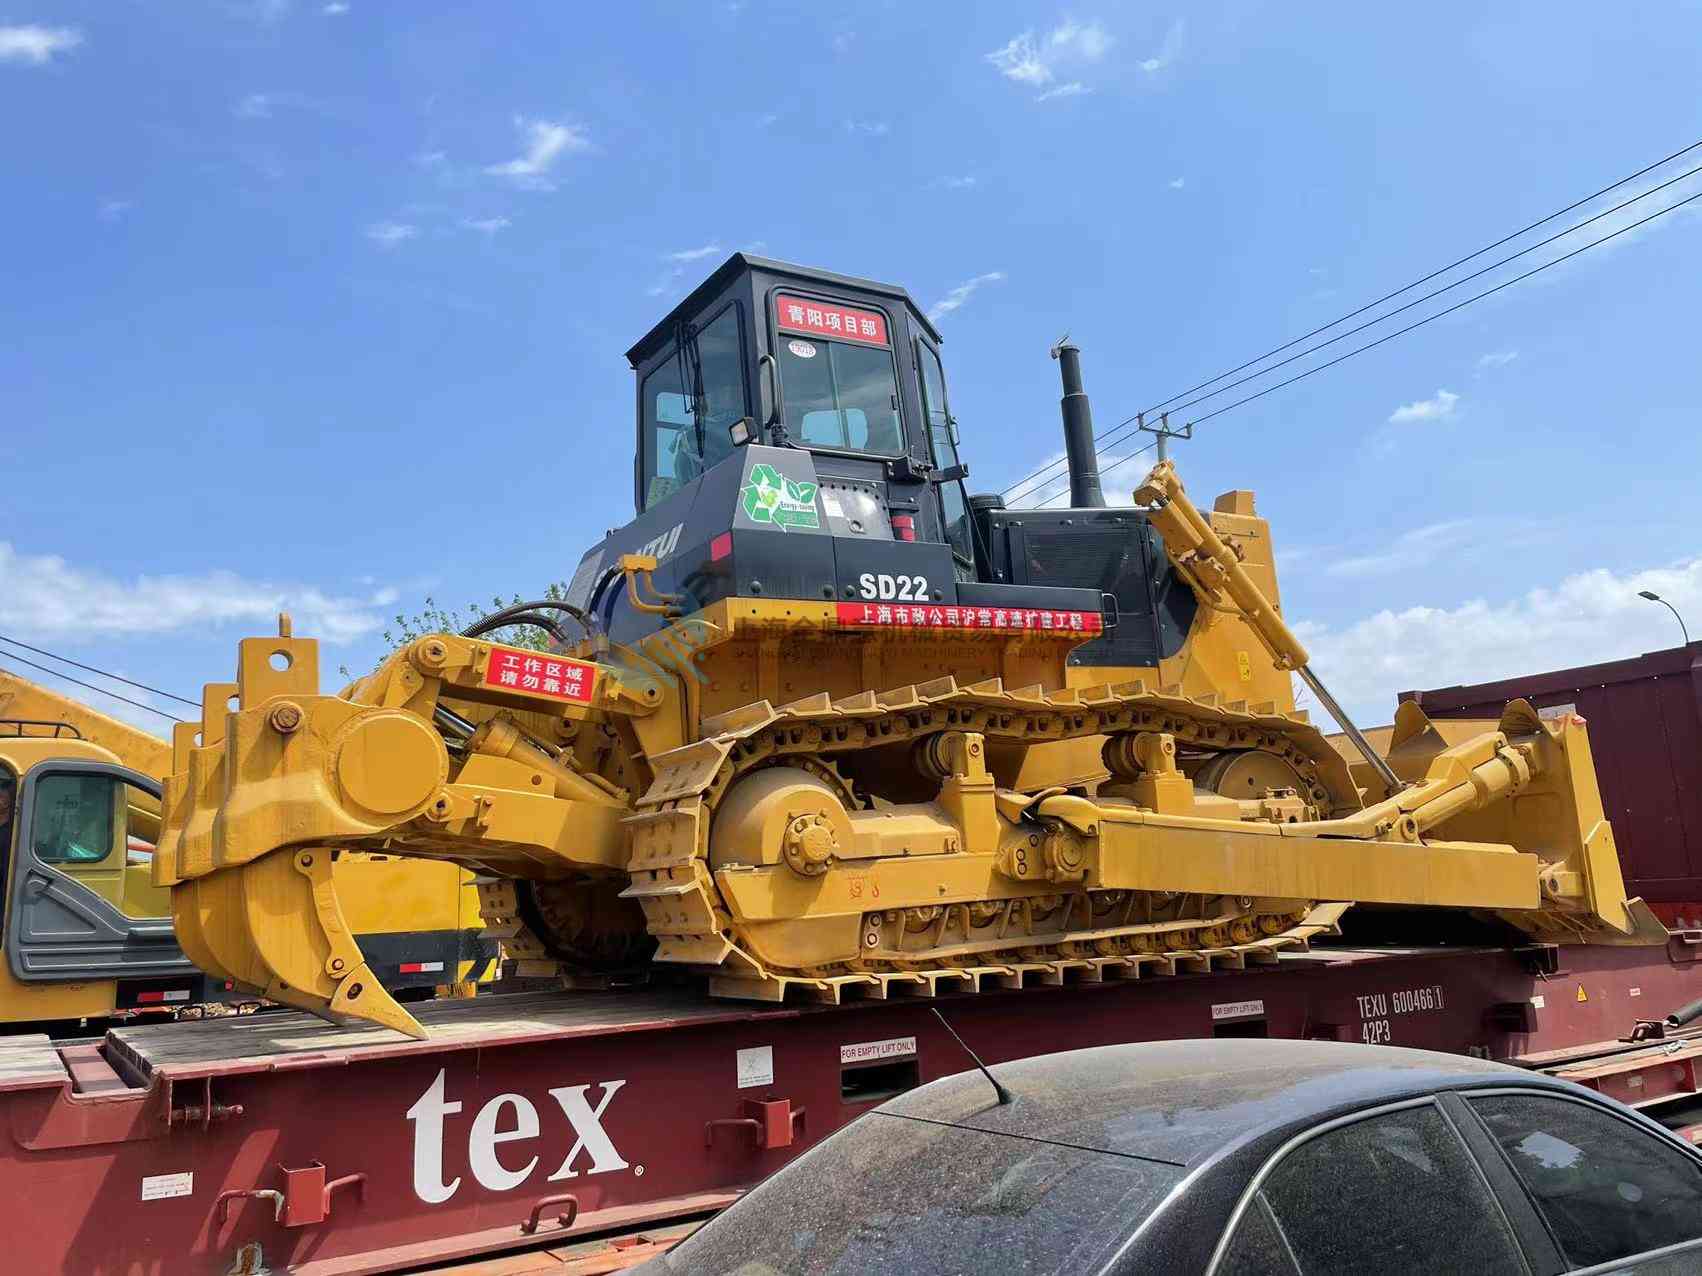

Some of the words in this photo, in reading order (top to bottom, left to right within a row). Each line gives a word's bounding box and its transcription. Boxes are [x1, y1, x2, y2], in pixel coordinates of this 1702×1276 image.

[787, 304, 877, 337] 青阳项目部
[859, 573, 930, 602] SD22
[502, 655, 584, 681] 工作区域
[500, 670, 581, 697] 请勿靠近
[1357, 993, 1388, 1018] TEXU
[1362, 1020, 1391, 1045] 42P3
[841, 1048, 856, 1058] FOR
[857, 1045, 880, 1057] EMPTY
[881, 1043, 896, 1054] LIFT
[896, 1039, 915, 1052] ONLY
[406, 1068, 630, 1204] tex
